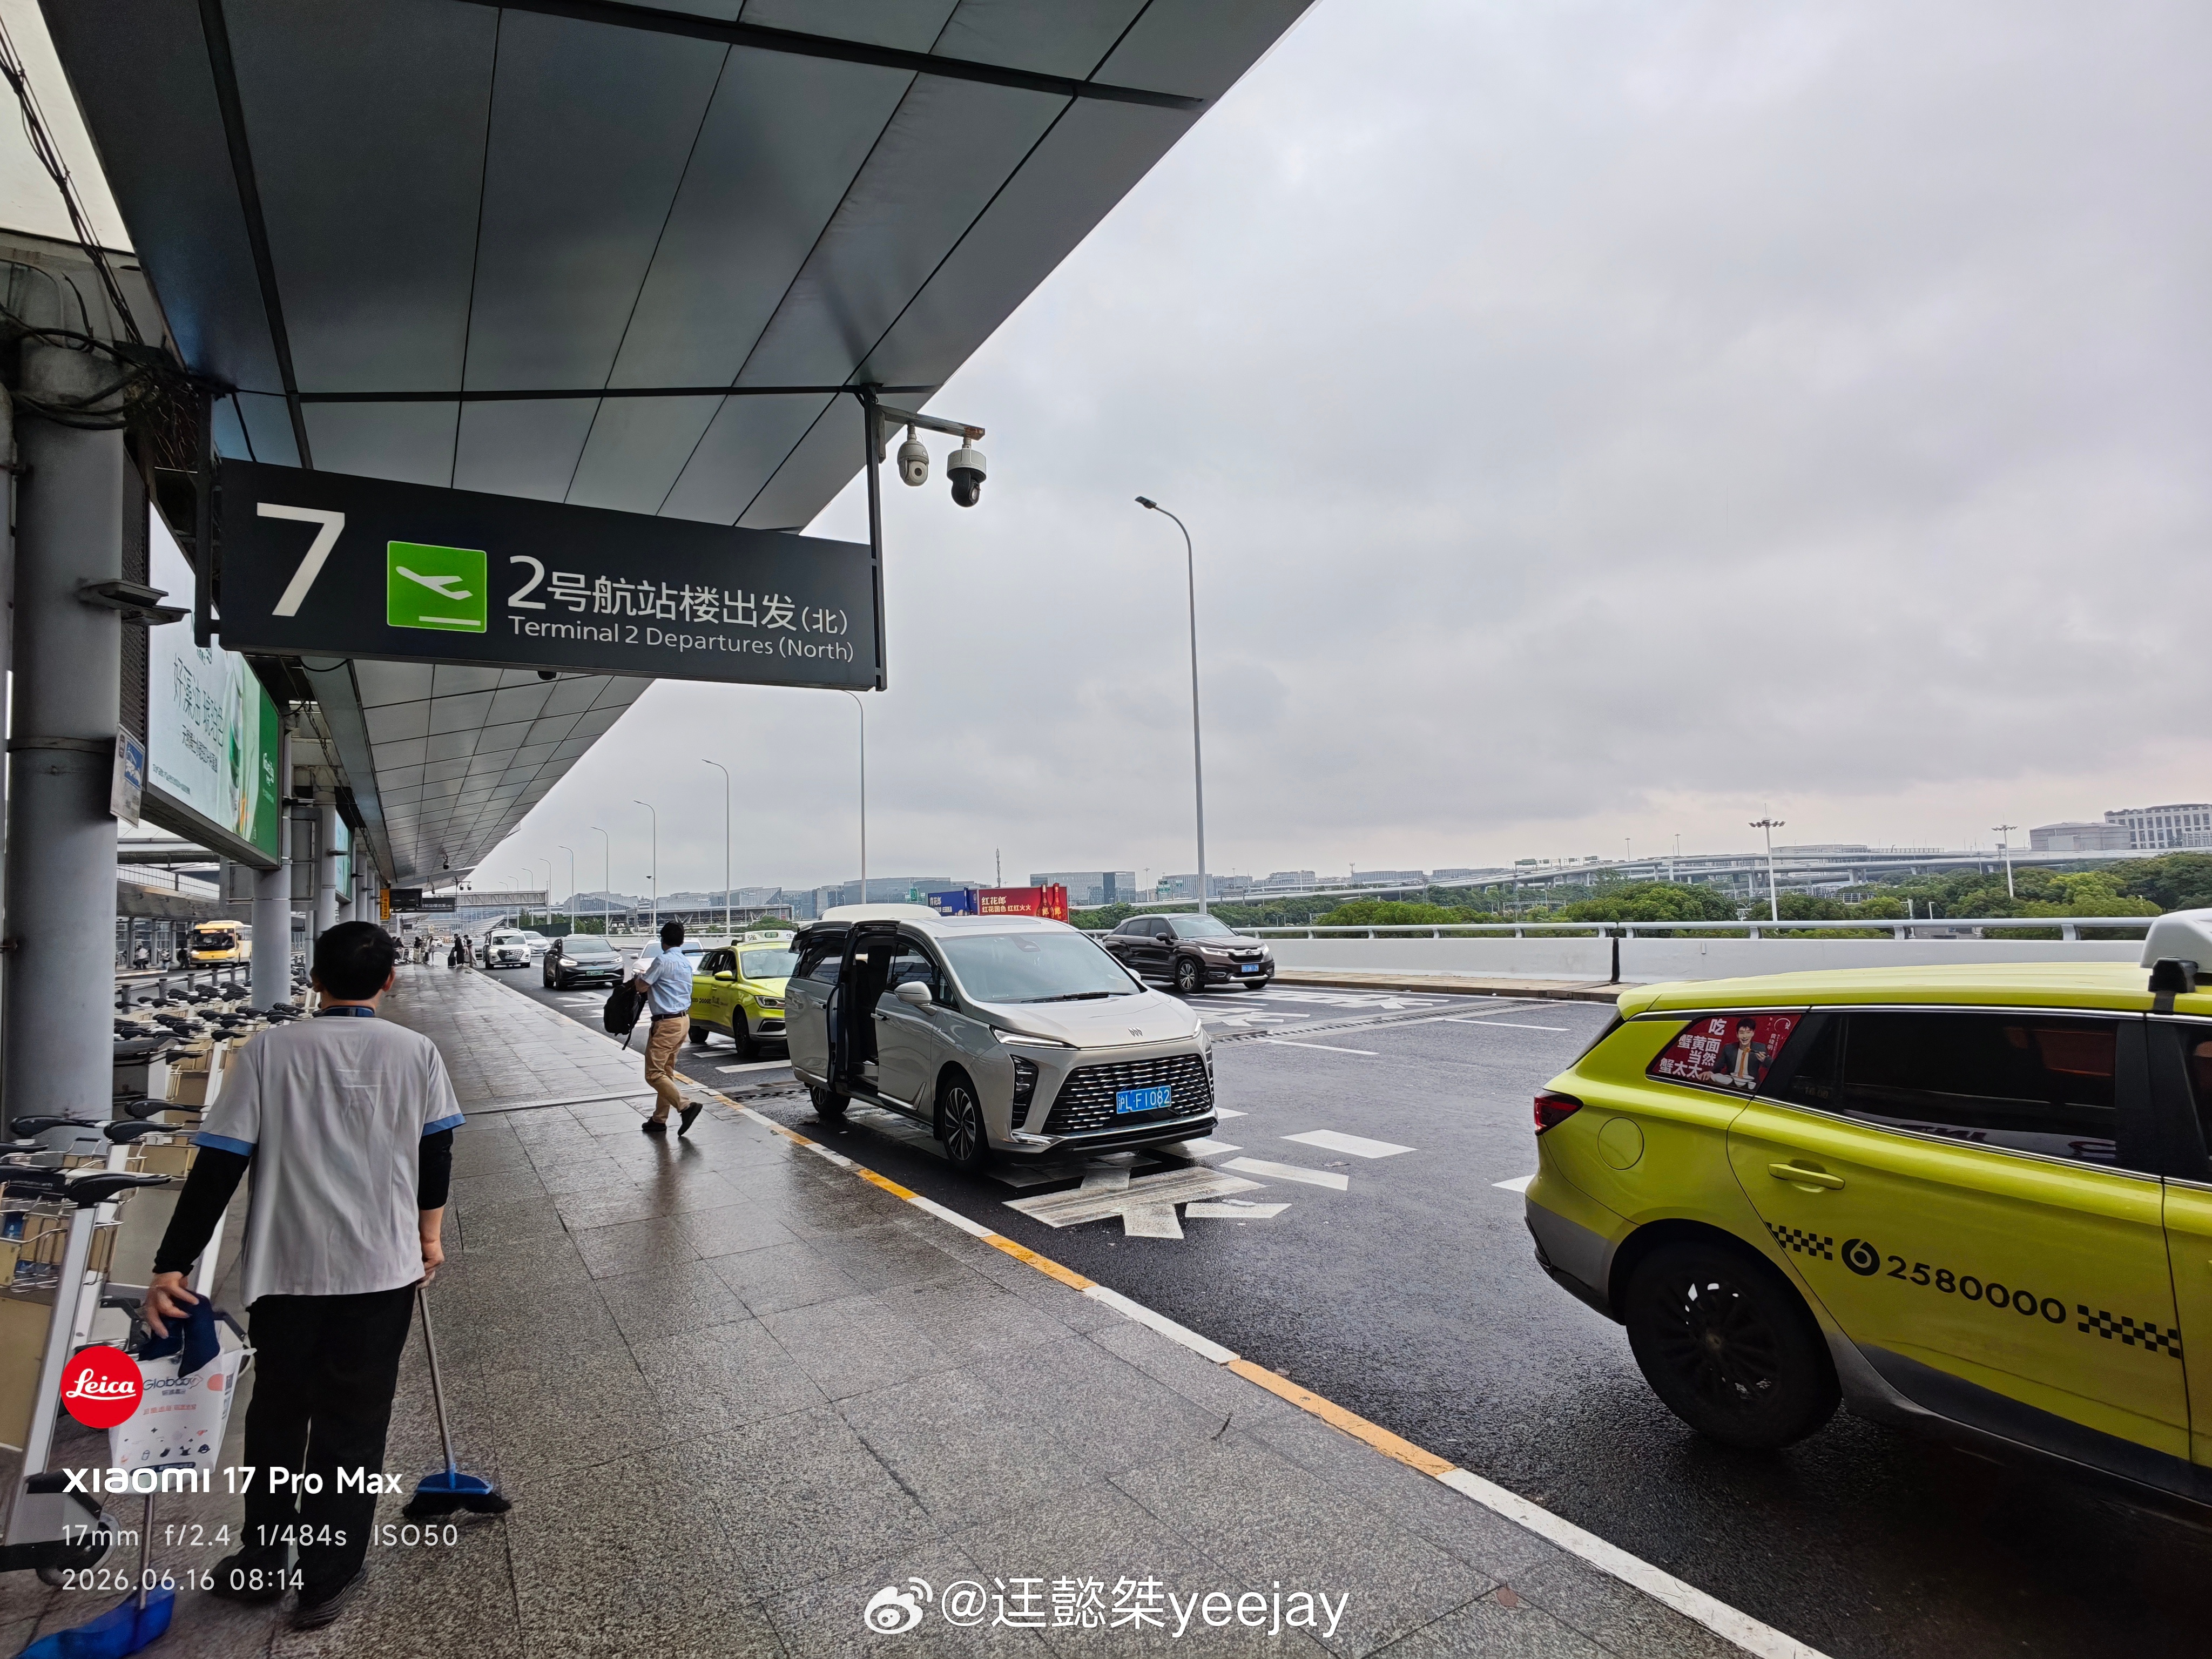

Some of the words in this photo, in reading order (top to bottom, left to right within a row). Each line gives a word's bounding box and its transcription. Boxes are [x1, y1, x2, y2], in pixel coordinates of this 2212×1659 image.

[257, 502, 345, 617] 7
[508, 615, 619, 643] Terminal
[625, 626, 639, 644] 2
[646, 626, 773, 655] Departures
[779, 636, 854, 663] (North)
[981, 896, 1006, 906] 红花郎
[1708, 1018, 1727, 1036] 吃
[1677, 1034, 1722, 1054] 蟹黄面
[1658, 1057, 1702, 1079] 蟹太太
[1688, 1050, 1716, 1067] 当然
[1886, 1255, 2066, 1324] 2580000
